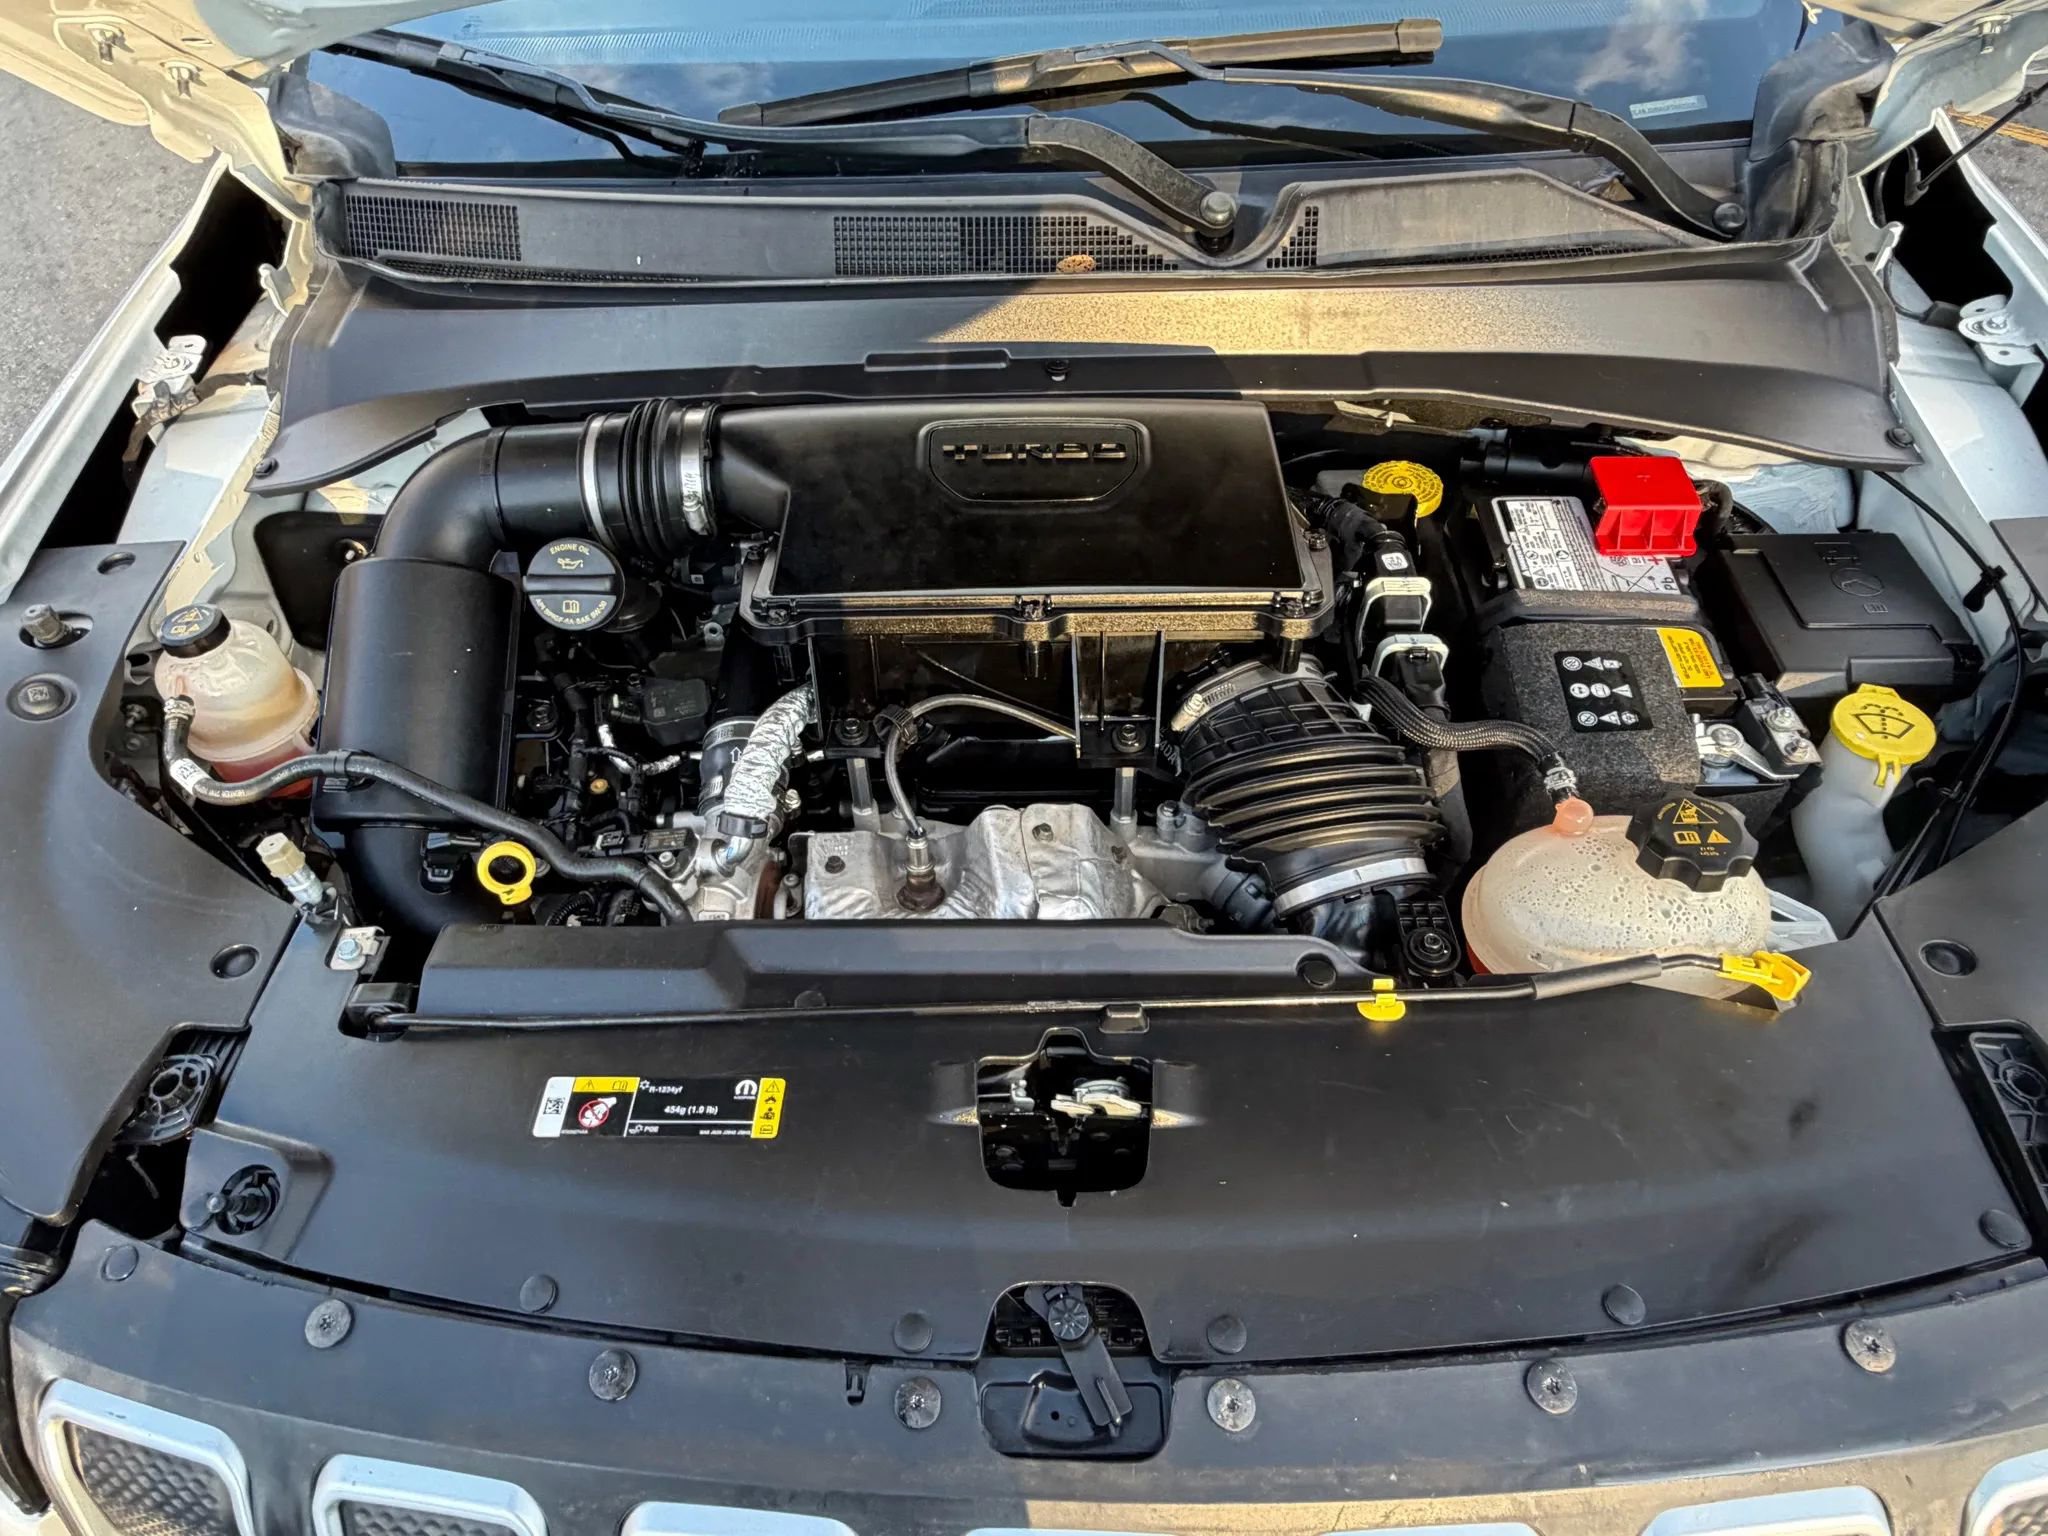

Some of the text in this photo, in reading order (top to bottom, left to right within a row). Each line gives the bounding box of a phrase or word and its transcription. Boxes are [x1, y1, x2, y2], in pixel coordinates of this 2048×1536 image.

[941, 443, 1127, 461] TURBO
[549, 543, 591, 556] ENGINE OIL
[1661, 577, 1678, 590] Pb
[648, 1085, 683, 1095] R-1234yf
[664, 1105, 719, 1116] 454g (1.0 lb)
